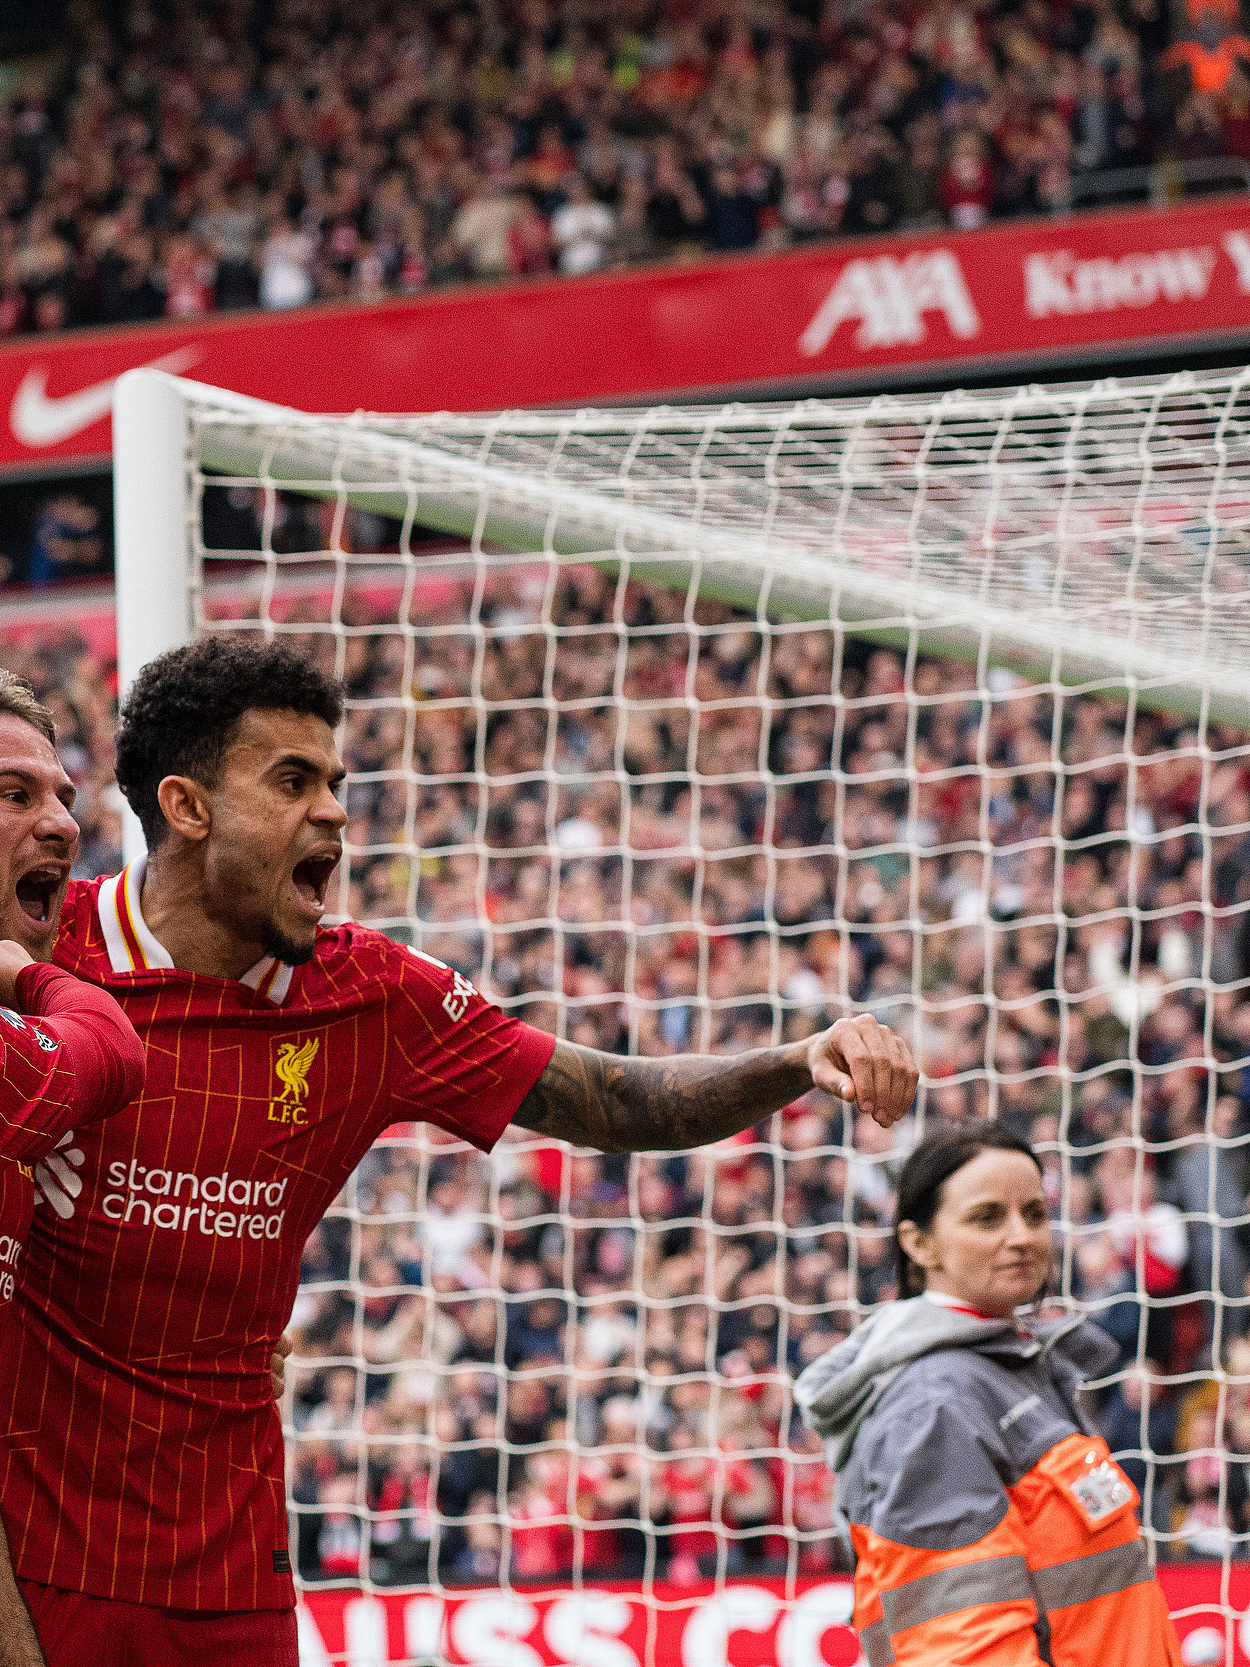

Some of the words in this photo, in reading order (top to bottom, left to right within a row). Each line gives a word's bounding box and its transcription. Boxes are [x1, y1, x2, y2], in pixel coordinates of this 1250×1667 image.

[799, 249, 982, 358] AXA
[1023, 246, 1218, 321] Know
[267, 1101, 309, 1125] L.F.C.
[106, 1158, 289, 1208] standard
[102, 1191, 286, 1240] chartered
